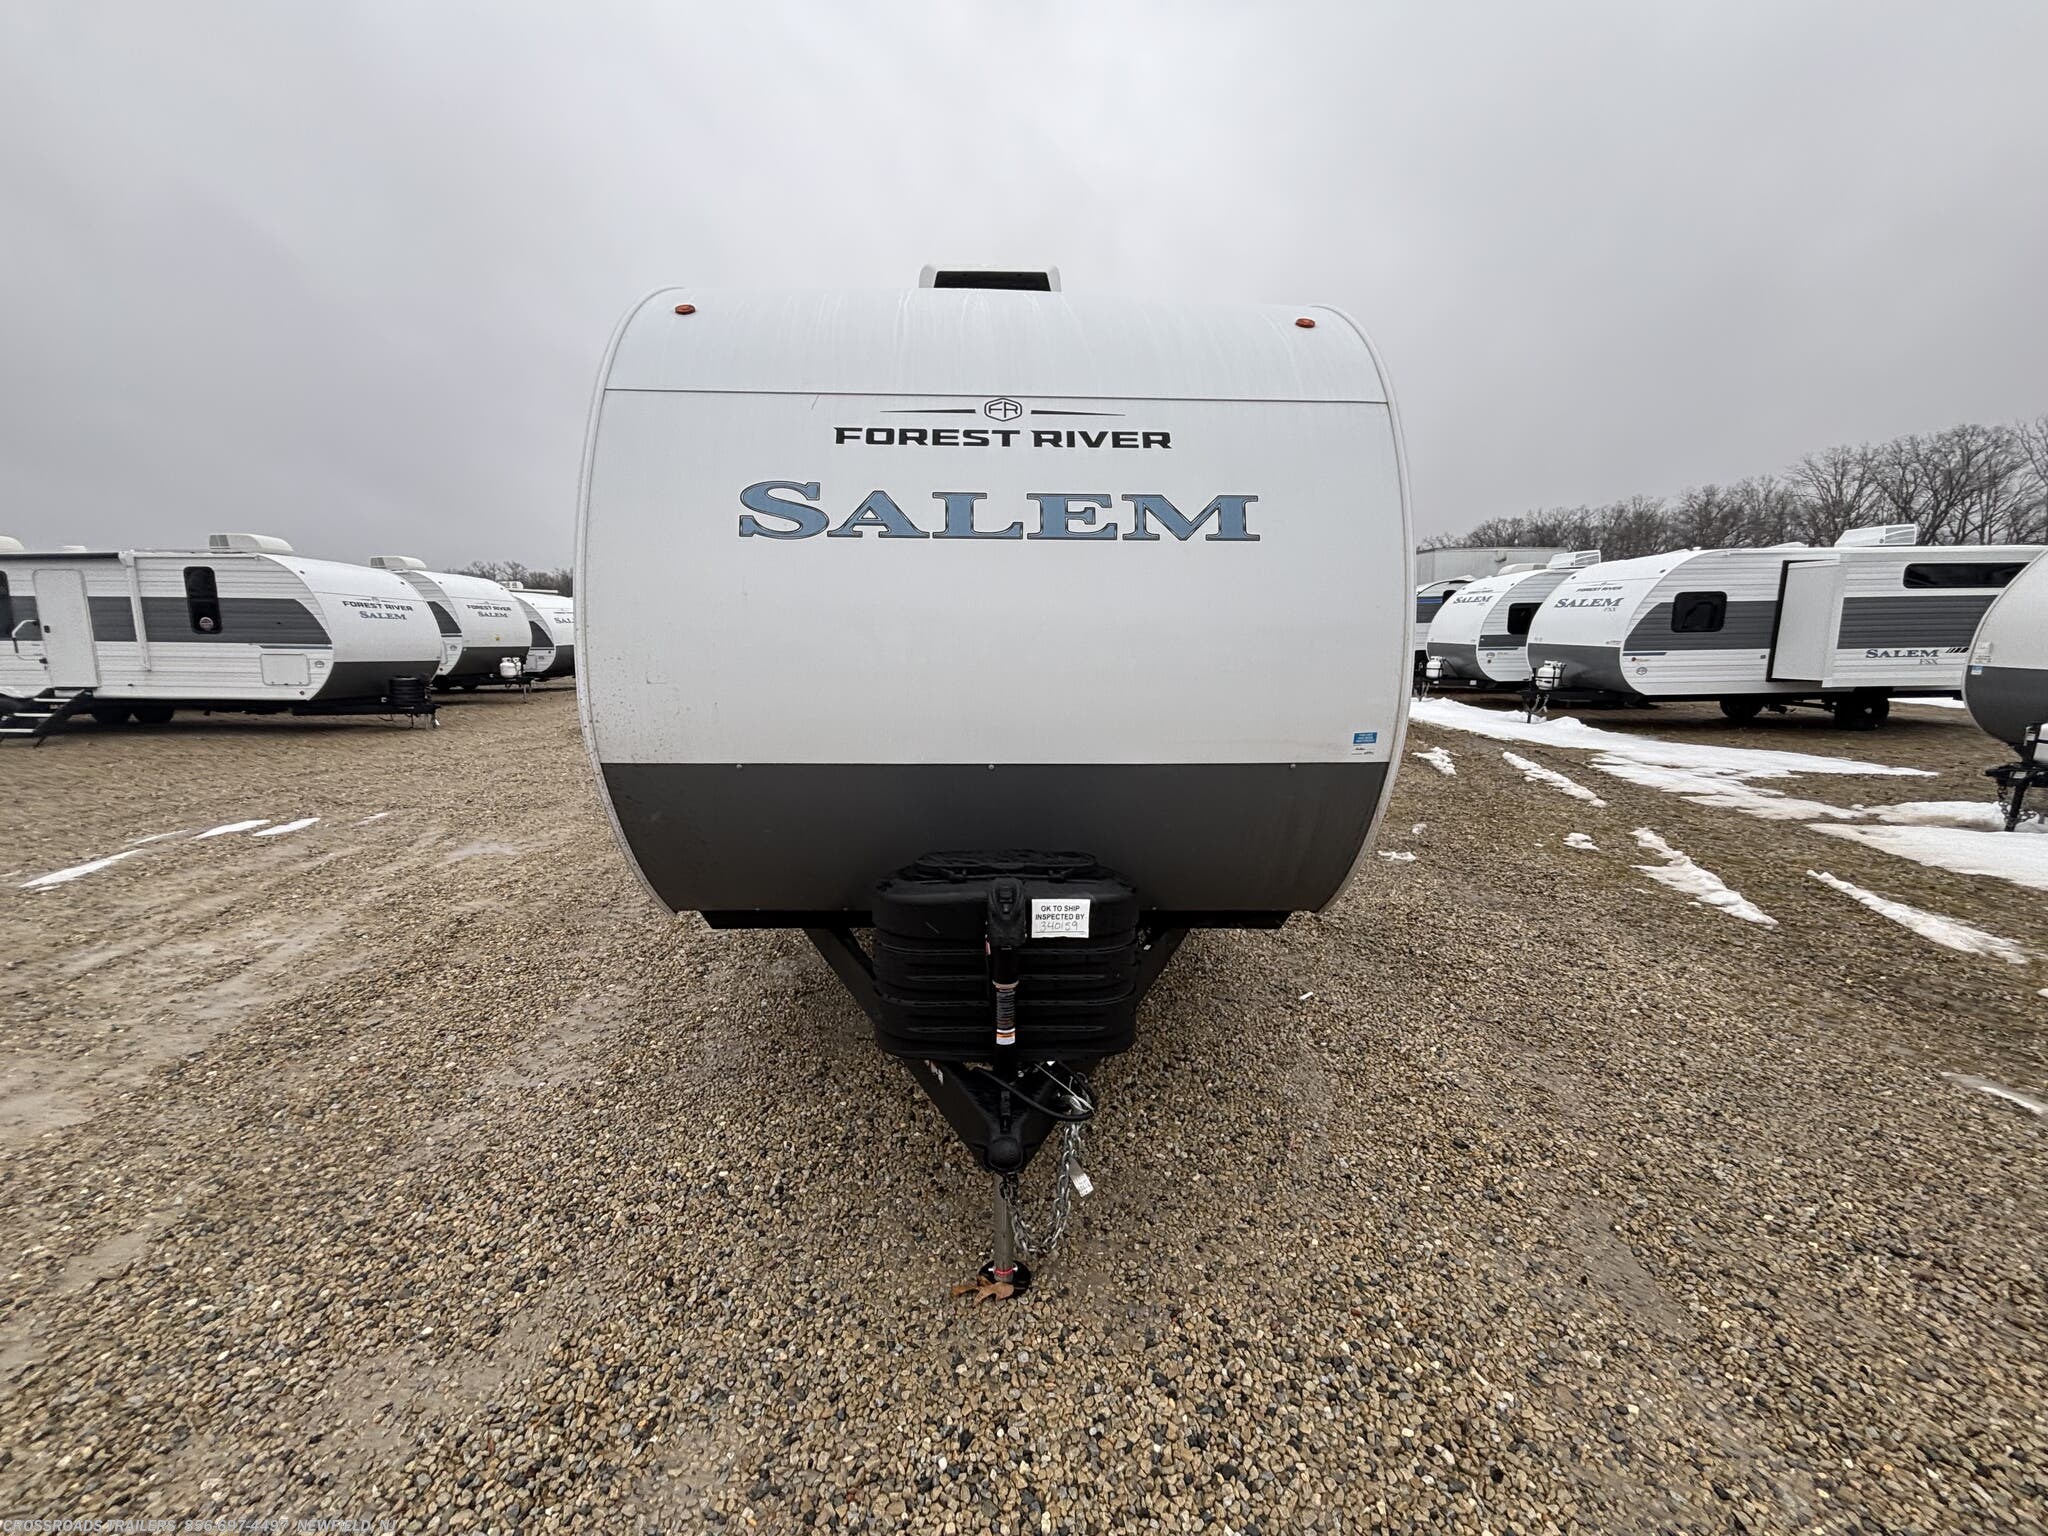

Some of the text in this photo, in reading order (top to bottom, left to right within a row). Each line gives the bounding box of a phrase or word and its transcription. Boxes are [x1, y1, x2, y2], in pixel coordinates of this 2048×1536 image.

[834, 427, 1172, 449] FOREST RIVER
[739, 480, 1260, 541] SALEM
[342, 600, 382, 609] FOREST
[1453, 595, 1493, 604] SALEM
[1554, 597, 1625, 608] SALEM
[359, 611, 407, 620] SALEM
[1865, 649, 1940, 659] SALEM
